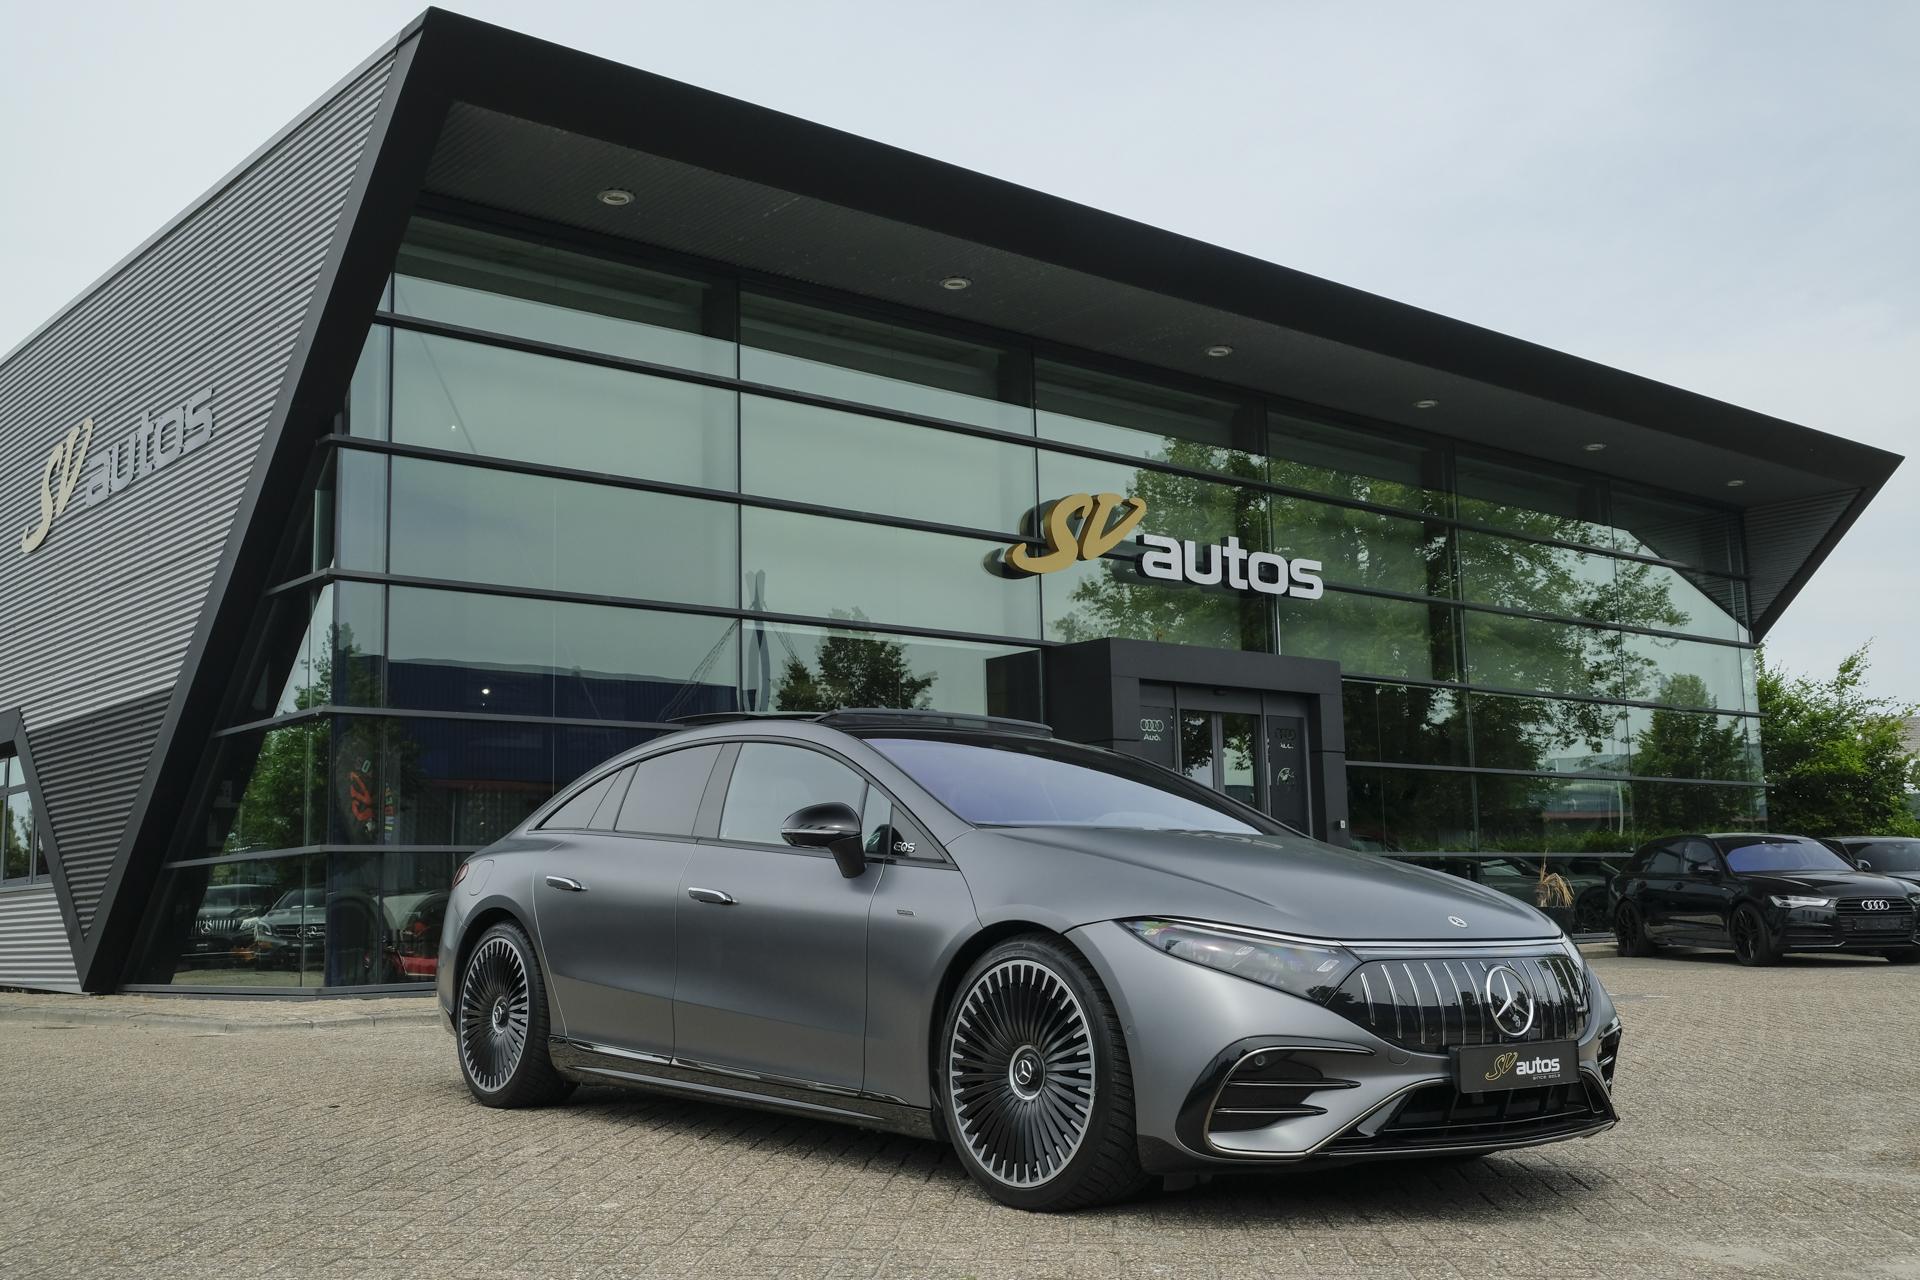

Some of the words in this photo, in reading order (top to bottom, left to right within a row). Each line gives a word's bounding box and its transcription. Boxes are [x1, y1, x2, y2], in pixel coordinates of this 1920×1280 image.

[85, 383, 214, 508] autos
[1138, 533, 1324, 600] autos
[893, 841, 916, 853] EQS
[1517, 1056, 1561, 1075] autos
